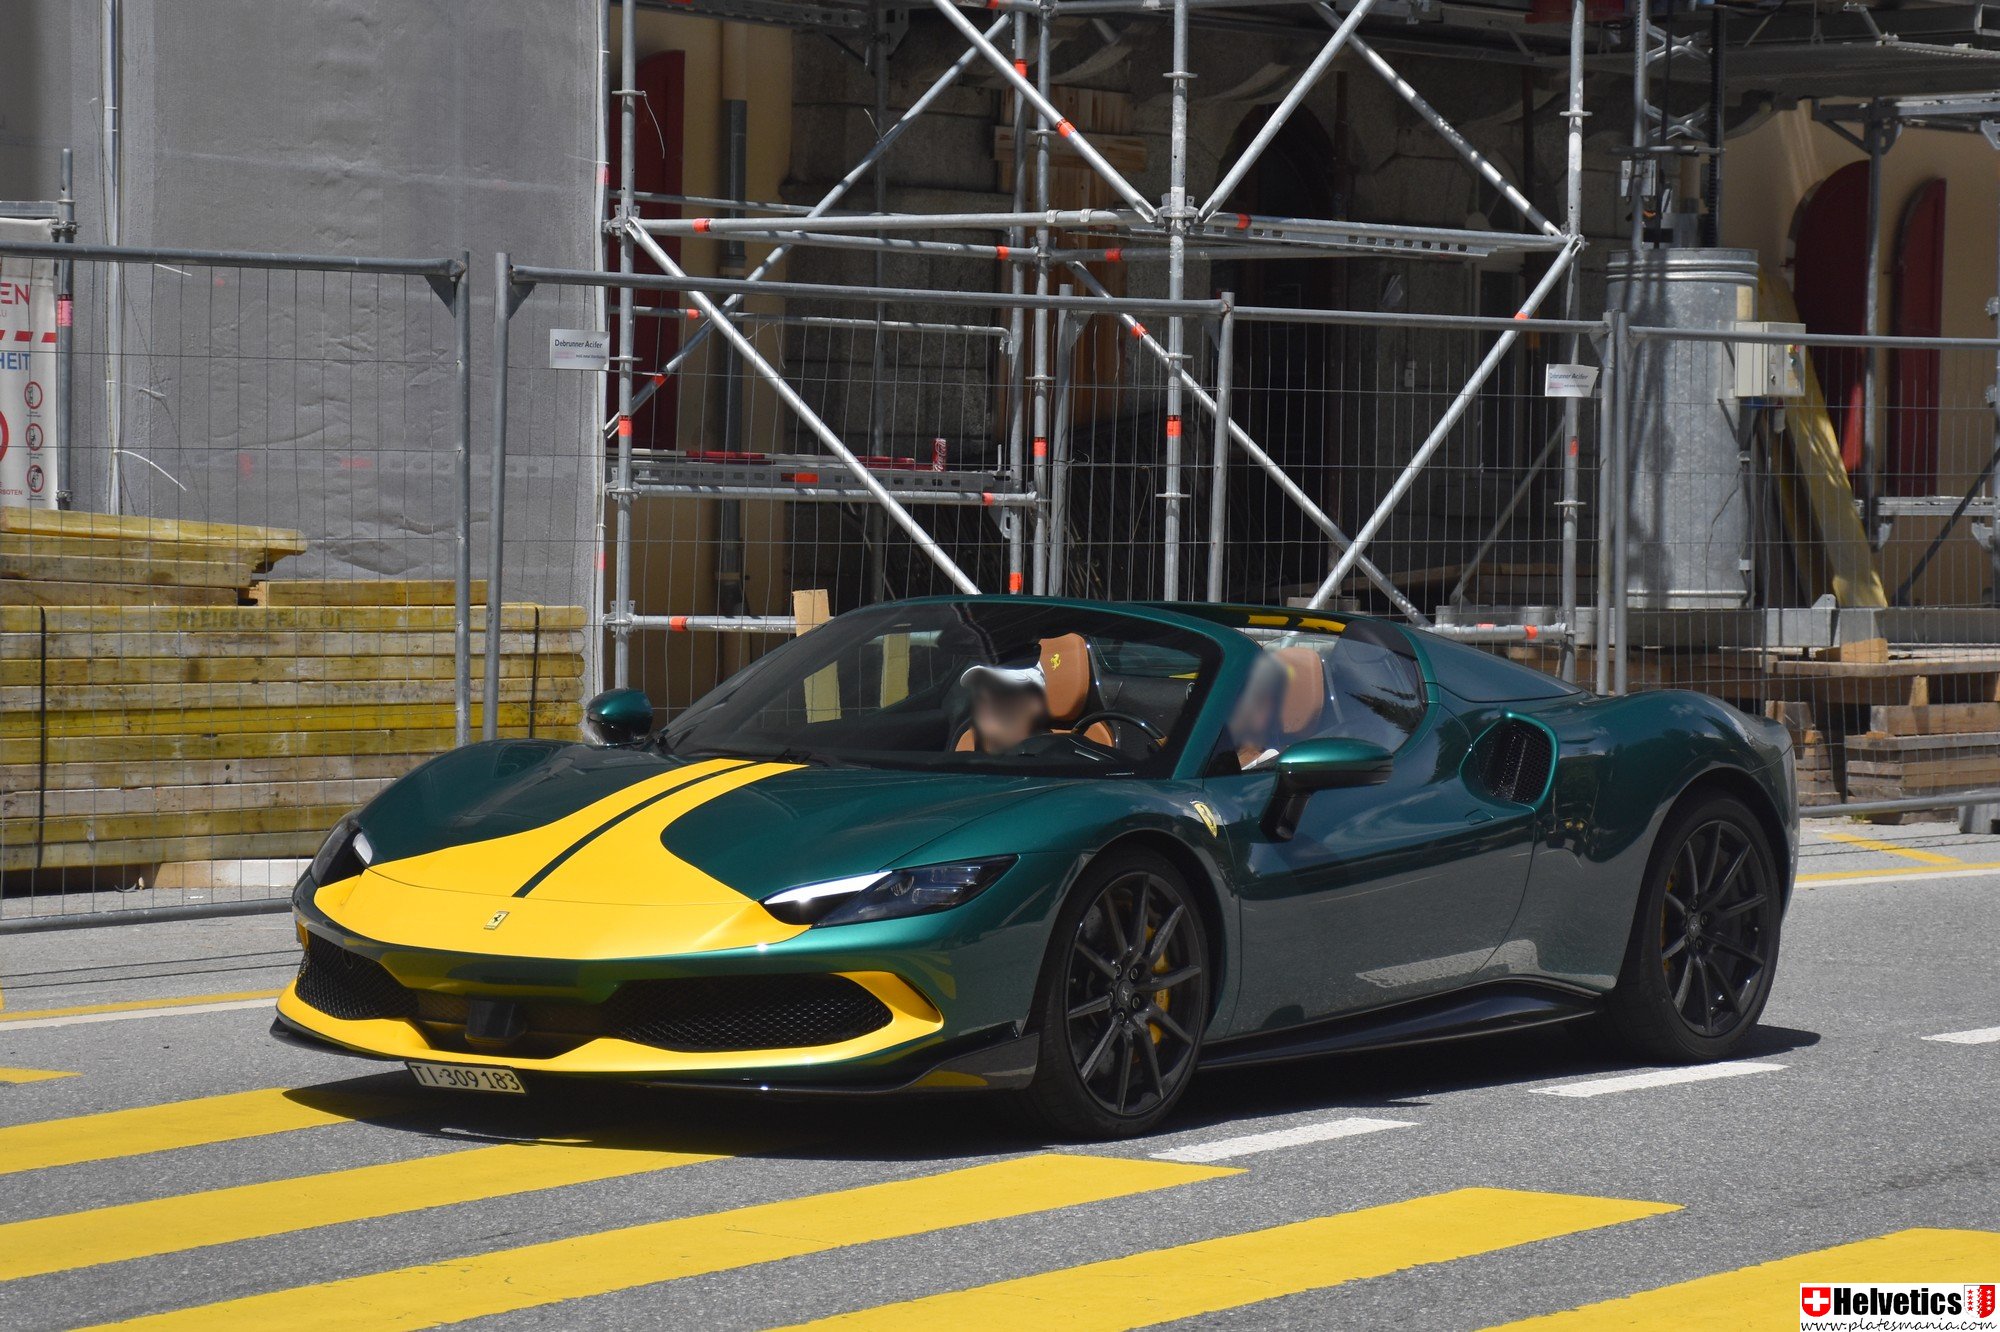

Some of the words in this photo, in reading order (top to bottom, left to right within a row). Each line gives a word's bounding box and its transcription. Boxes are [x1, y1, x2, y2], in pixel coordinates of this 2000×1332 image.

[554, 339, 585, 348] Debrunner
[585, 341, 603, 349] Acifer
[481, 1071, 520, 1091] 183
